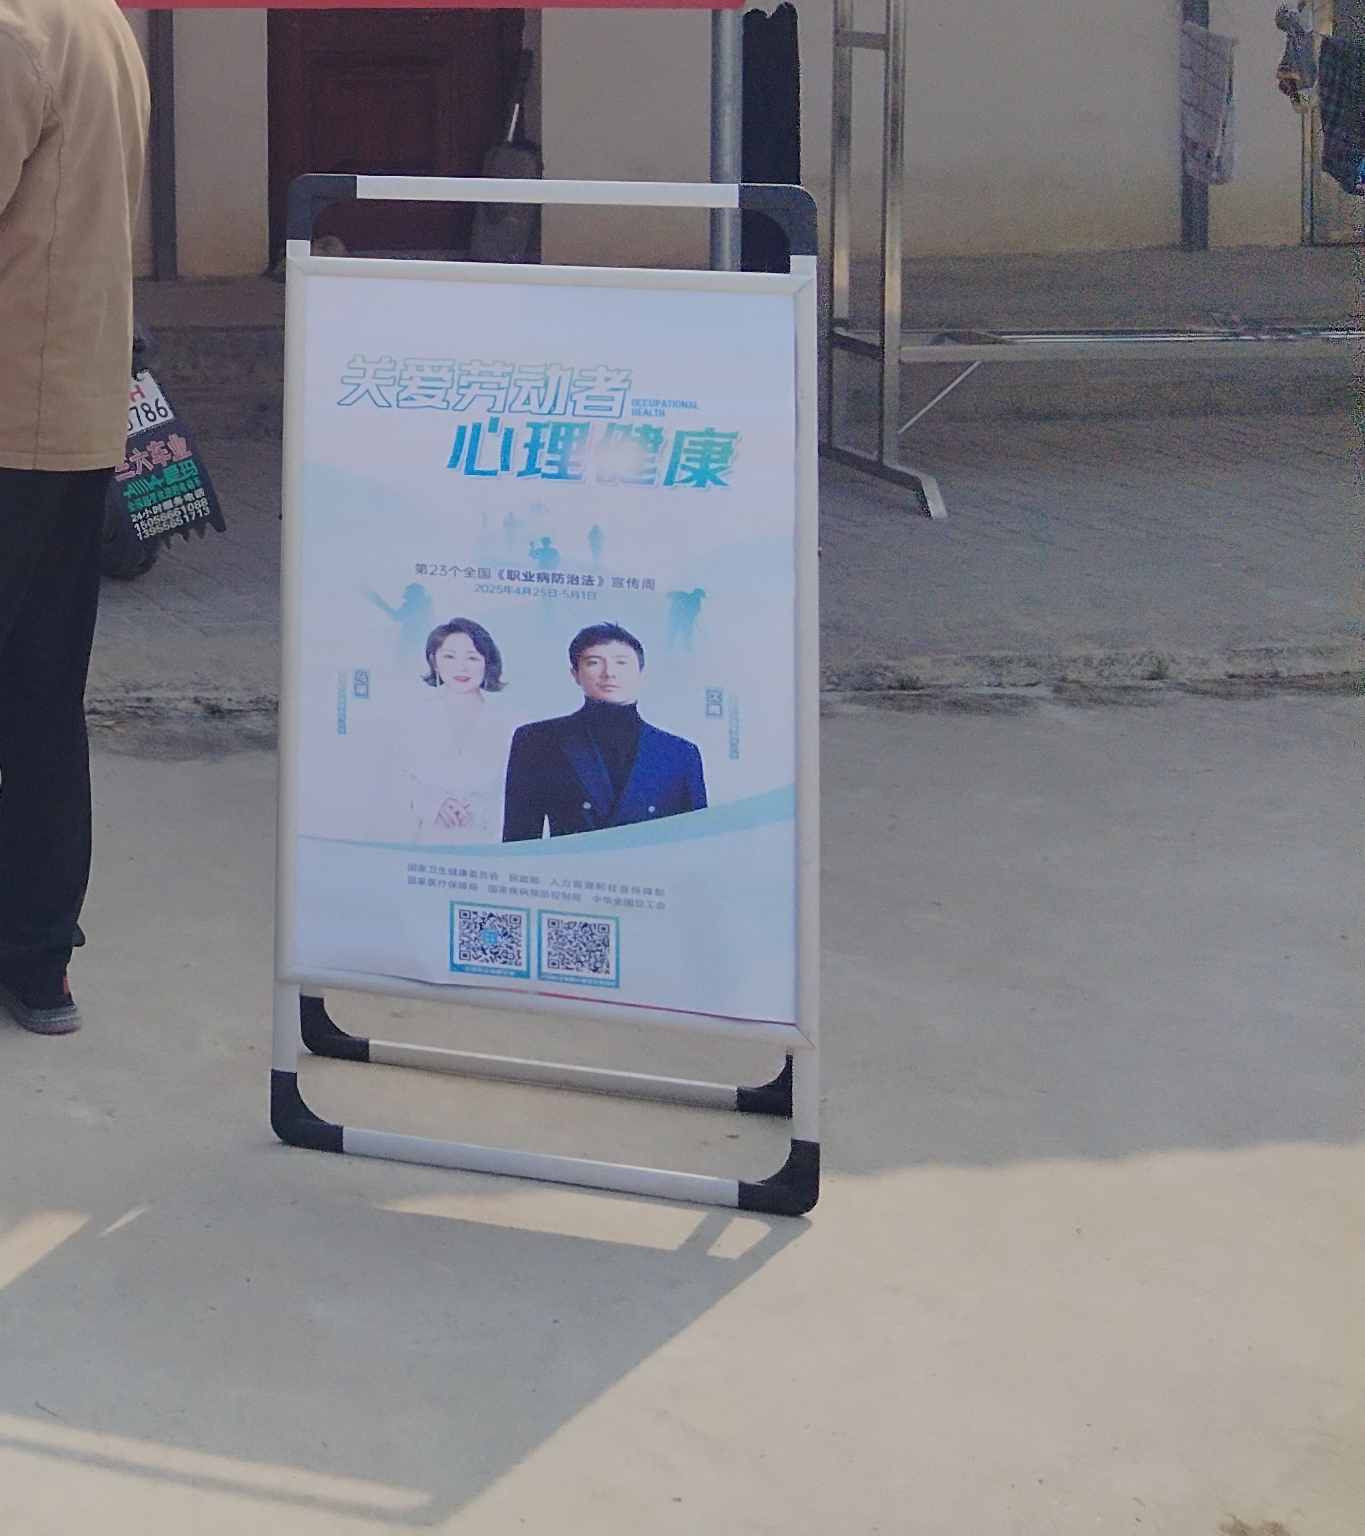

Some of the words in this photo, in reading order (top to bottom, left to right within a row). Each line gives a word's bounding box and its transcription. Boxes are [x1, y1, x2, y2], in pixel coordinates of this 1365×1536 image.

[336, 354, 634, 419] 关爱劳动者
[631, 398, 700, 411] OCCUPATIONAL
[631, 408, 667, 419] HEALTH
[446, 417, 740, 491] 心理健康
[414, 562, 656, 591] 第23个全国《职业病防治法》宣传周
